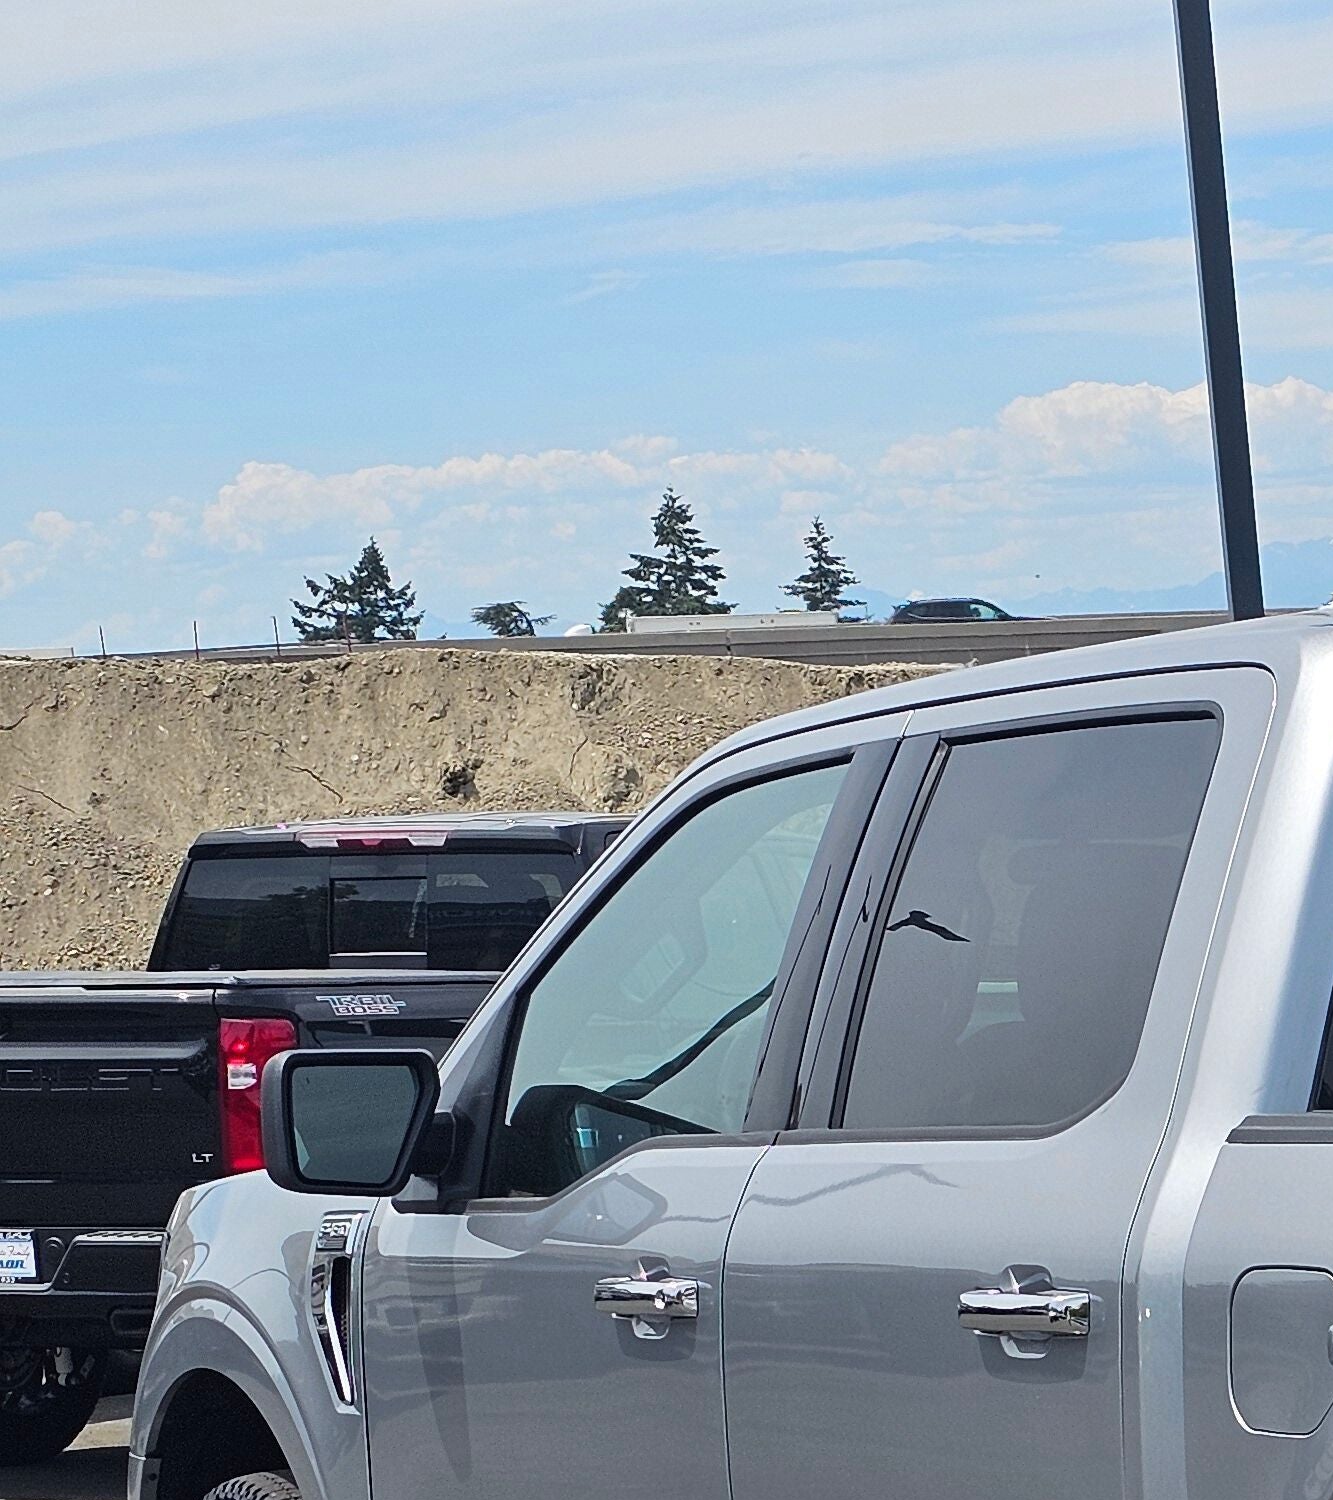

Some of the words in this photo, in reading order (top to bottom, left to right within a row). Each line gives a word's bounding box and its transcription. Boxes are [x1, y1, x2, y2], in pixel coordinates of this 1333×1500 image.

[315, 994, 407, 1007] TRAIL
[333, 1006, 400, 1016] BOSS
[191, 1153, 214, 1163] LT
